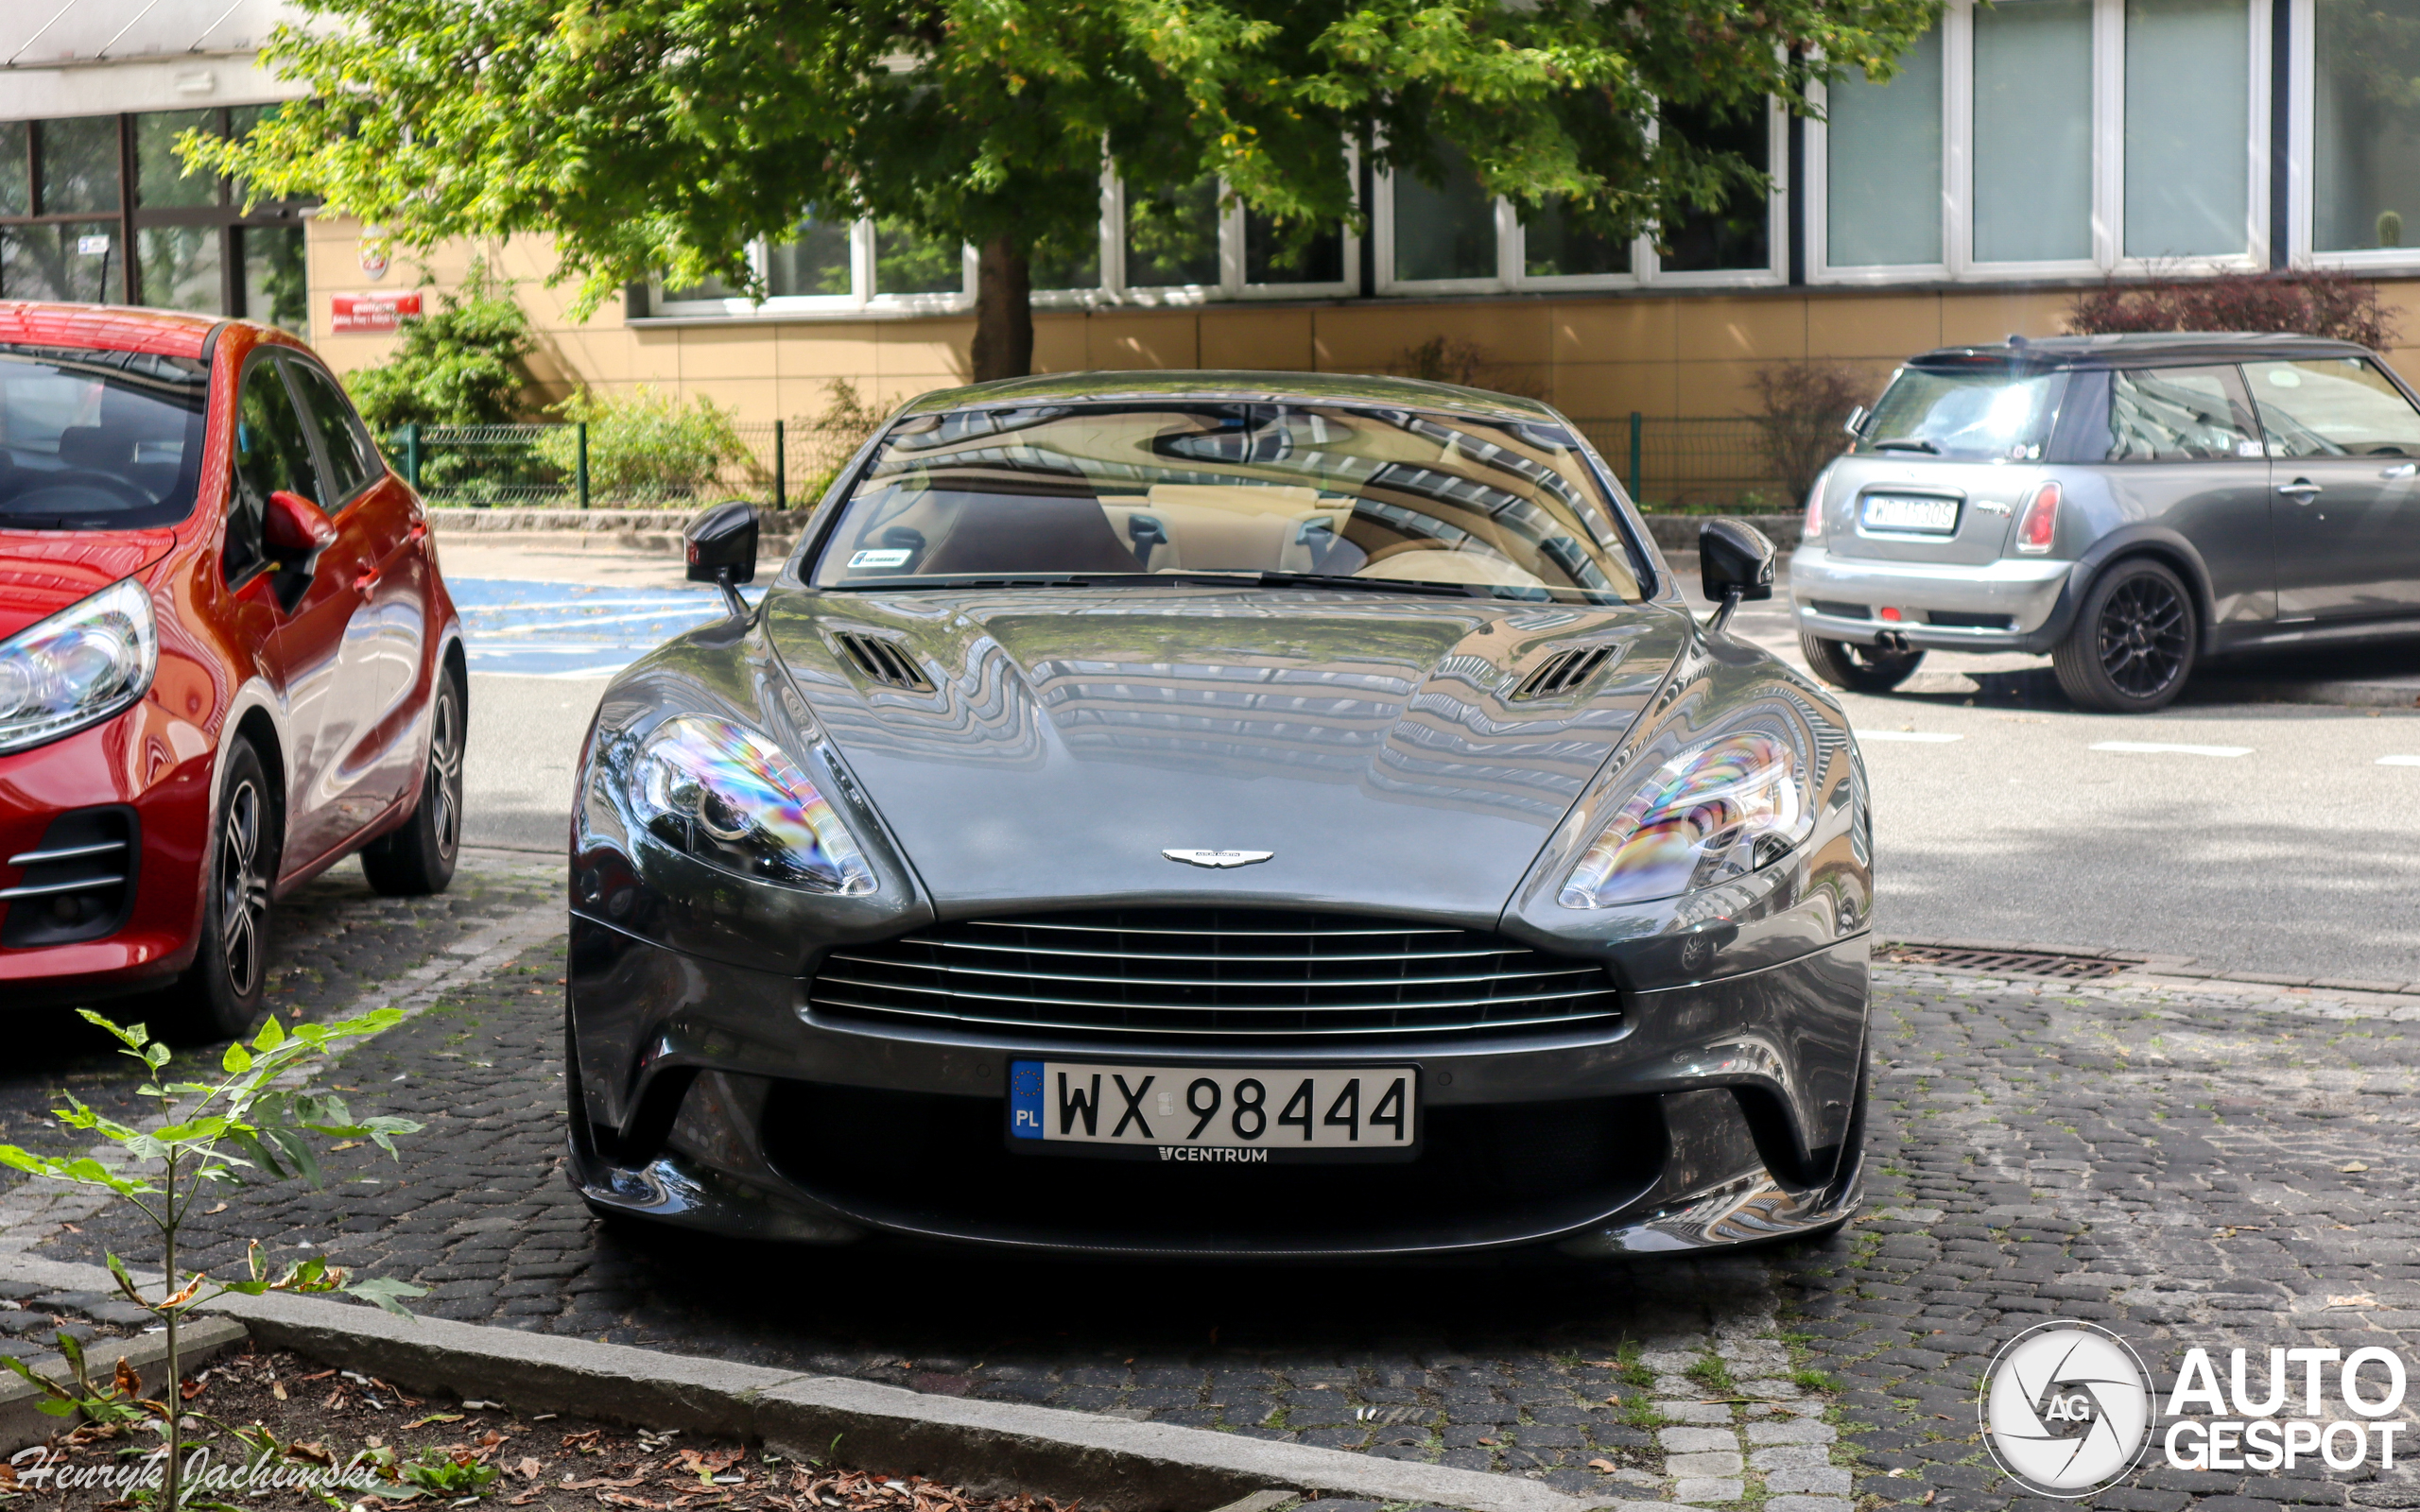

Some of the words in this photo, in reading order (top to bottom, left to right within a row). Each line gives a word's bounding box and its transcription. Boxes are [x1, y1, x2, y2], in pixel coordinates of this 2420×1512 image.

[1015, 1109, 1040, 1128] PL
[1057, 1072, 1155, 1139] WX
[1185, 1077, 1407, 1142] 98444
